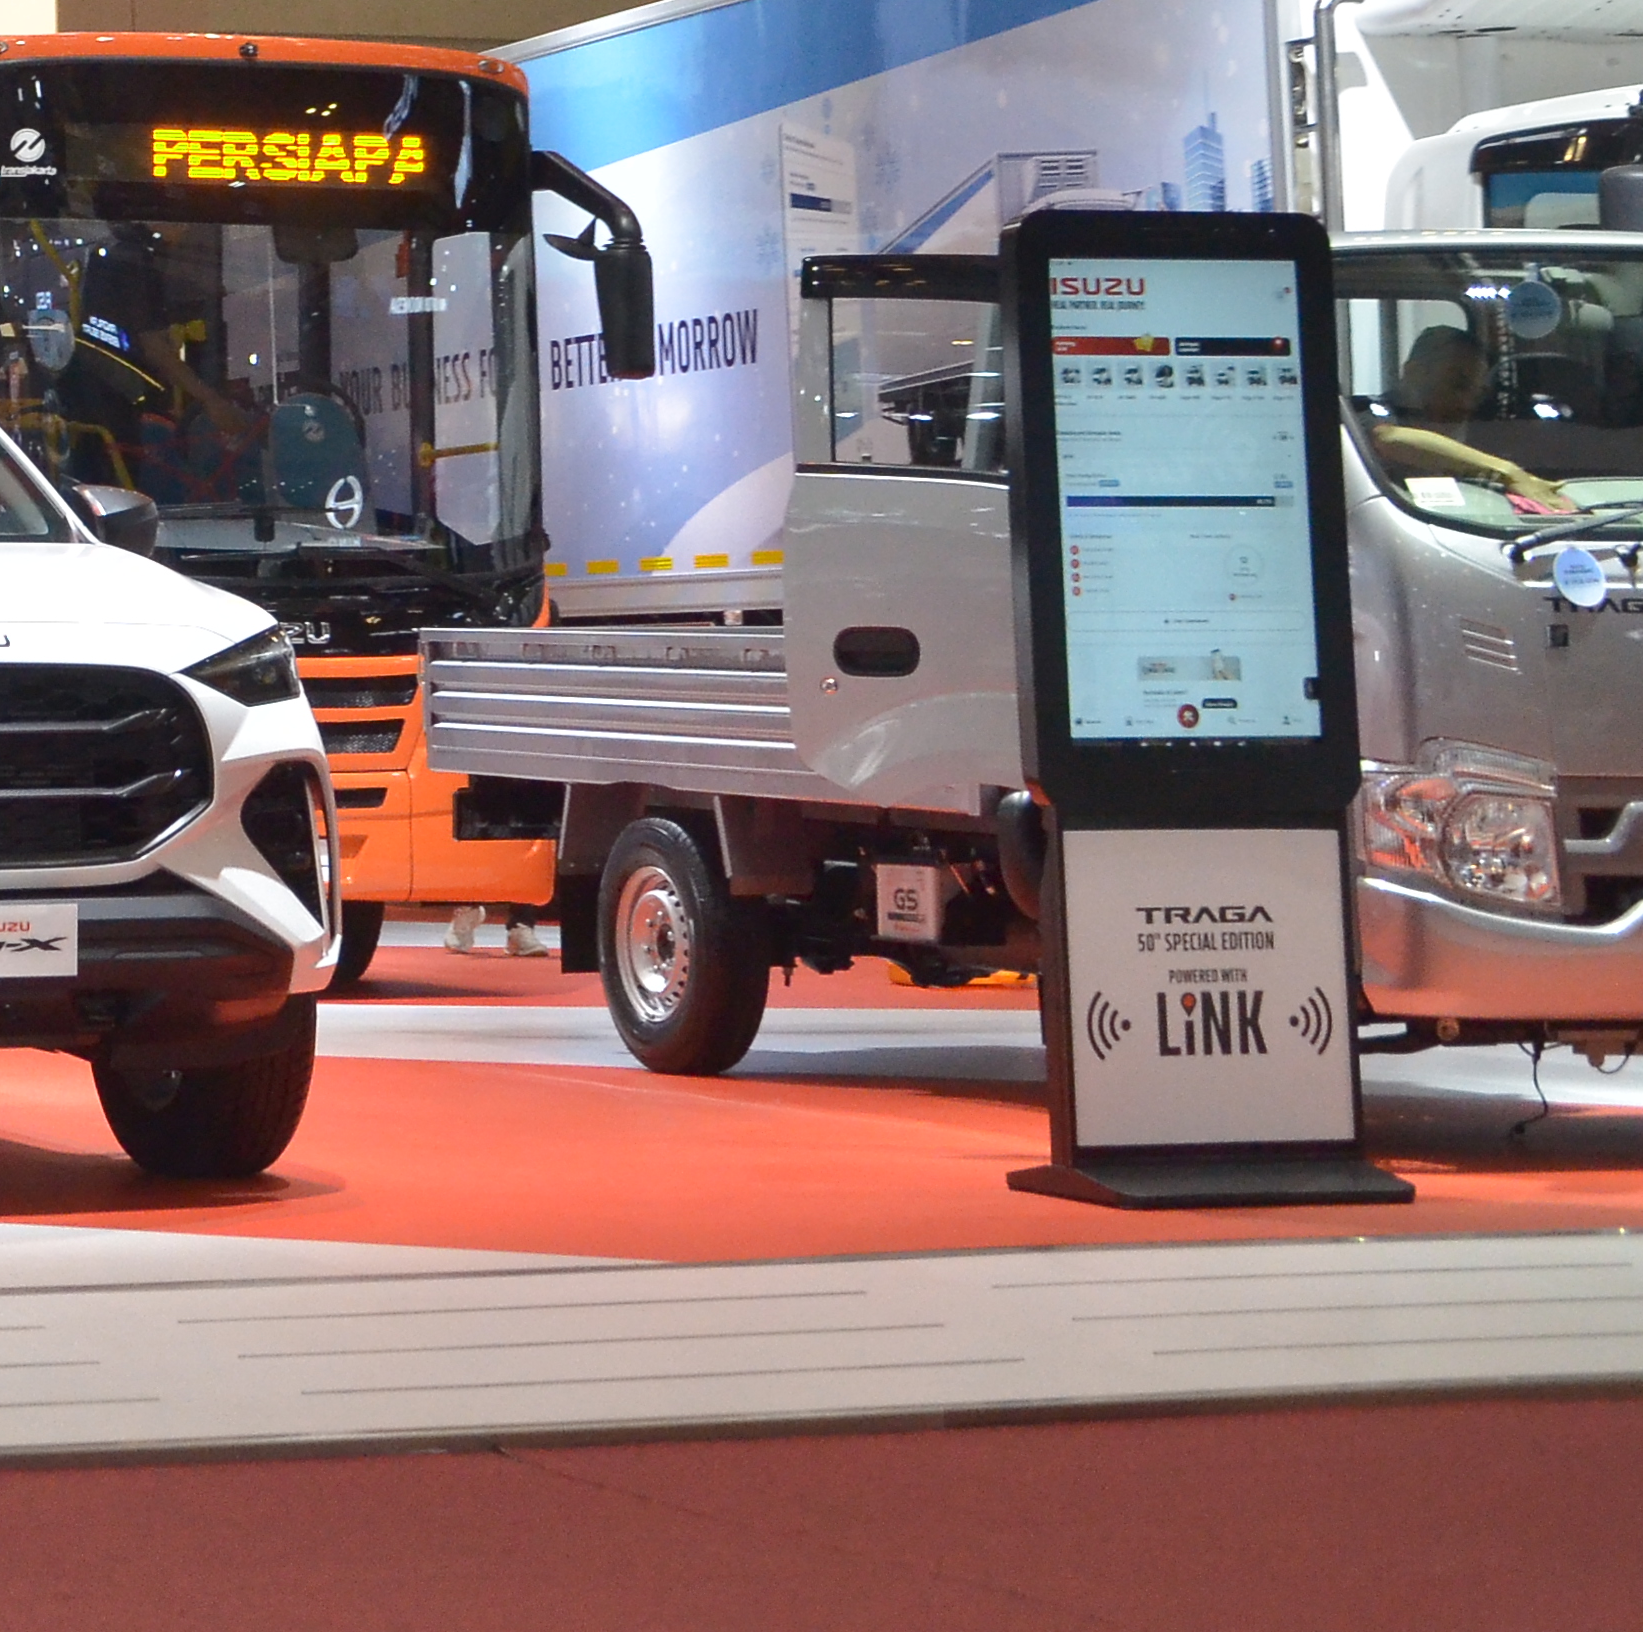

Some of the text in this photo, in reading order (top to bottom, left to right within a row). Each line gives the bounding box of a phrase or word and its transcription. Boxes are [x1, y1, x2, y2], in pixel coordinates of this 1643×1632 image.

[153, 129, 424, 184] PERSIAPA
[1051, 277, 1145, 295] ISUZU
[480, 347, 498, 399] FO
[550, 333, 608, 390] BETTE
[658, 309, 758, 376] MORROW
[894, 888, 918, 911] GS
[1136, 905, 1274, 924] TRAGA
[1165, 932, 1218, 952] SPECIAL
[1221, 931, 1275, 950] EDITION
[1169, 969, 1248, 984] POWERED WITH
